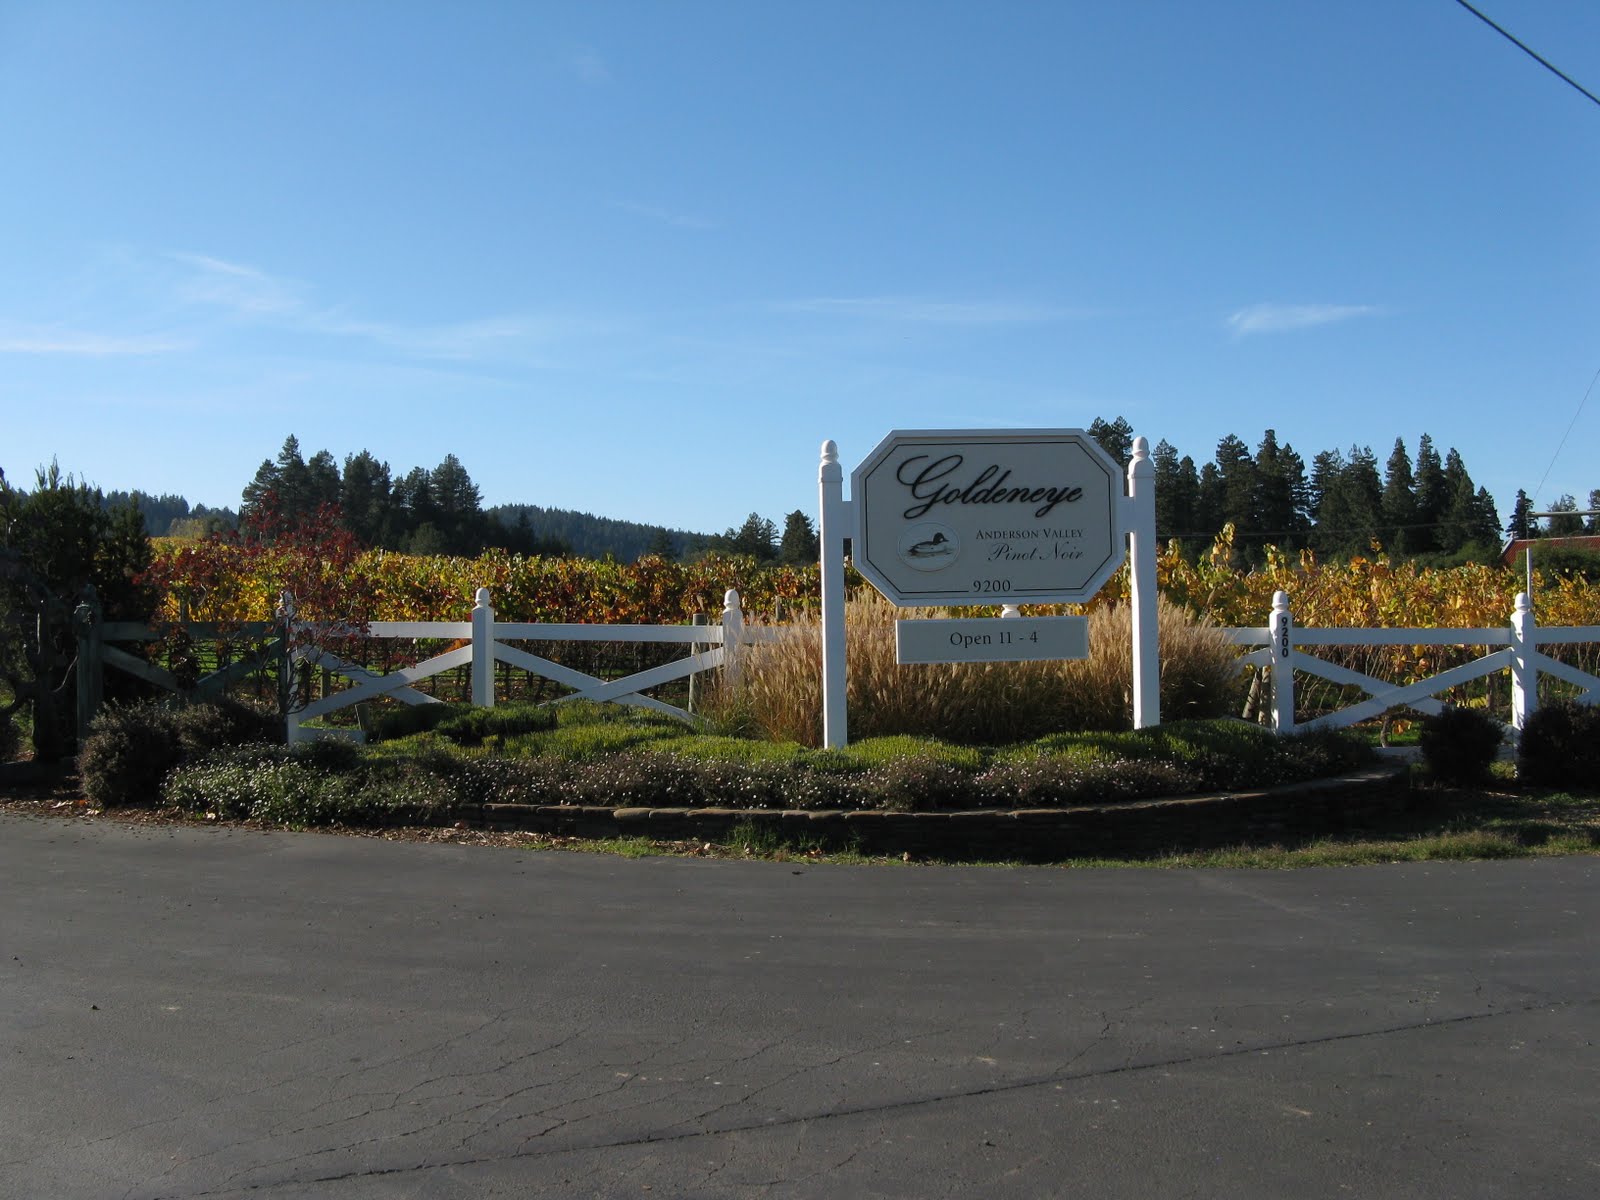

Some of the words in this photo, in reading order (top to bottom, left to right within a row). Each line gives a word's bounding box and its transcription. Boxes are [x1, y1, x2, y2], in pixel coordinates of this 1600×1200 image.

[896, 454, 1083, 519] Goldeneye
[976, 529, 1039, 540] ANDERSON
[1042, 528, 1084, 539] VALLEY
[987, 542, 1036, 561] Pinot
[1038, 541, 1084, 561] Noir
[972, 579, 1011, 593] 9200
[949, 632, 992, 648] Open
[999, 631, 1012, 644] 11
[1029, 631, 1039, 643] 4
